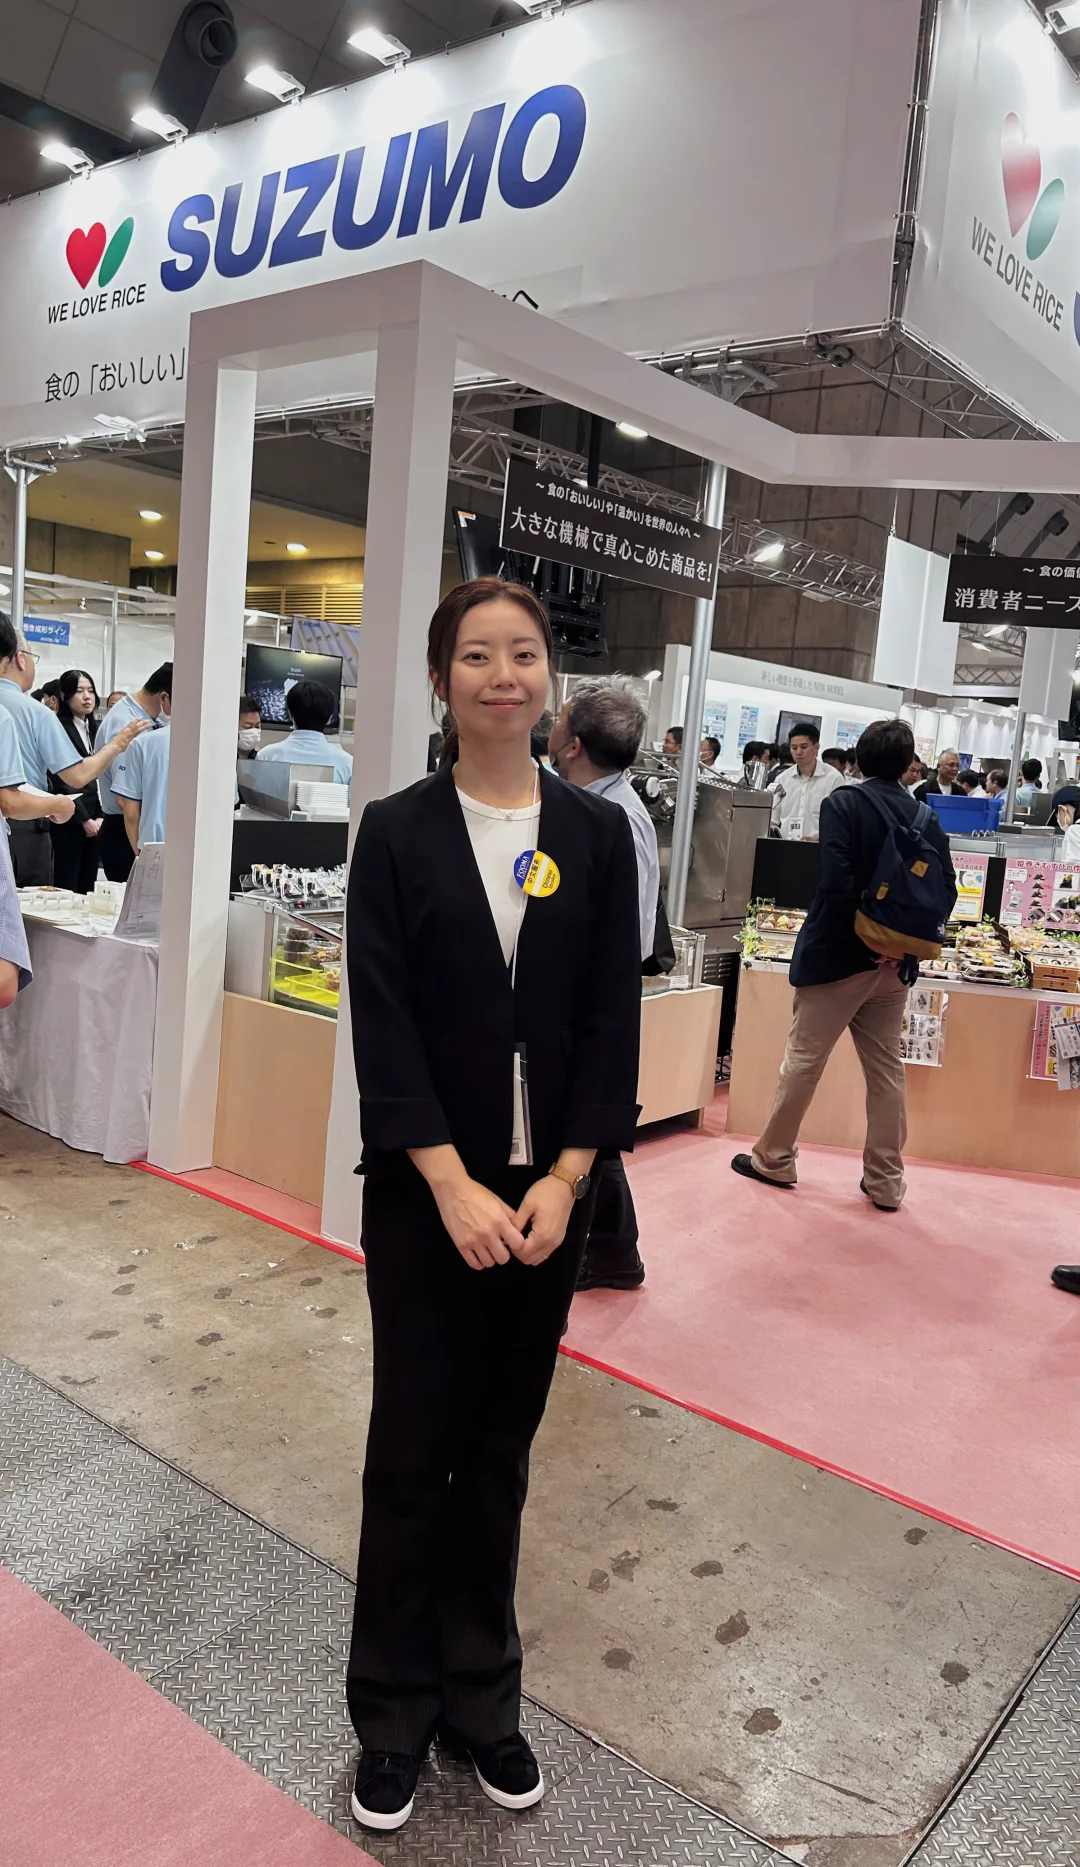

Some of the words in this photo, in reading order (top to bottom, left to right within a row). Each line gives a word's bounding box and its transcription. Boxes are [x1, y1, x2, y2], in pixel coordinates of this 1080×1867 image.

[159, 84, 587, 293] SUZUMO
[48, 303, 68, 324] WE
[72, 293, 108, 319] LOVE
[111, 283, 147, 310] RICE
[972, 216, 996, 267] WE
[996, 244, 1033, 302] LOVE
[1033, 280, 1064, 332] RICE
[45, 347, 185, 403] 食の「おいしい」
